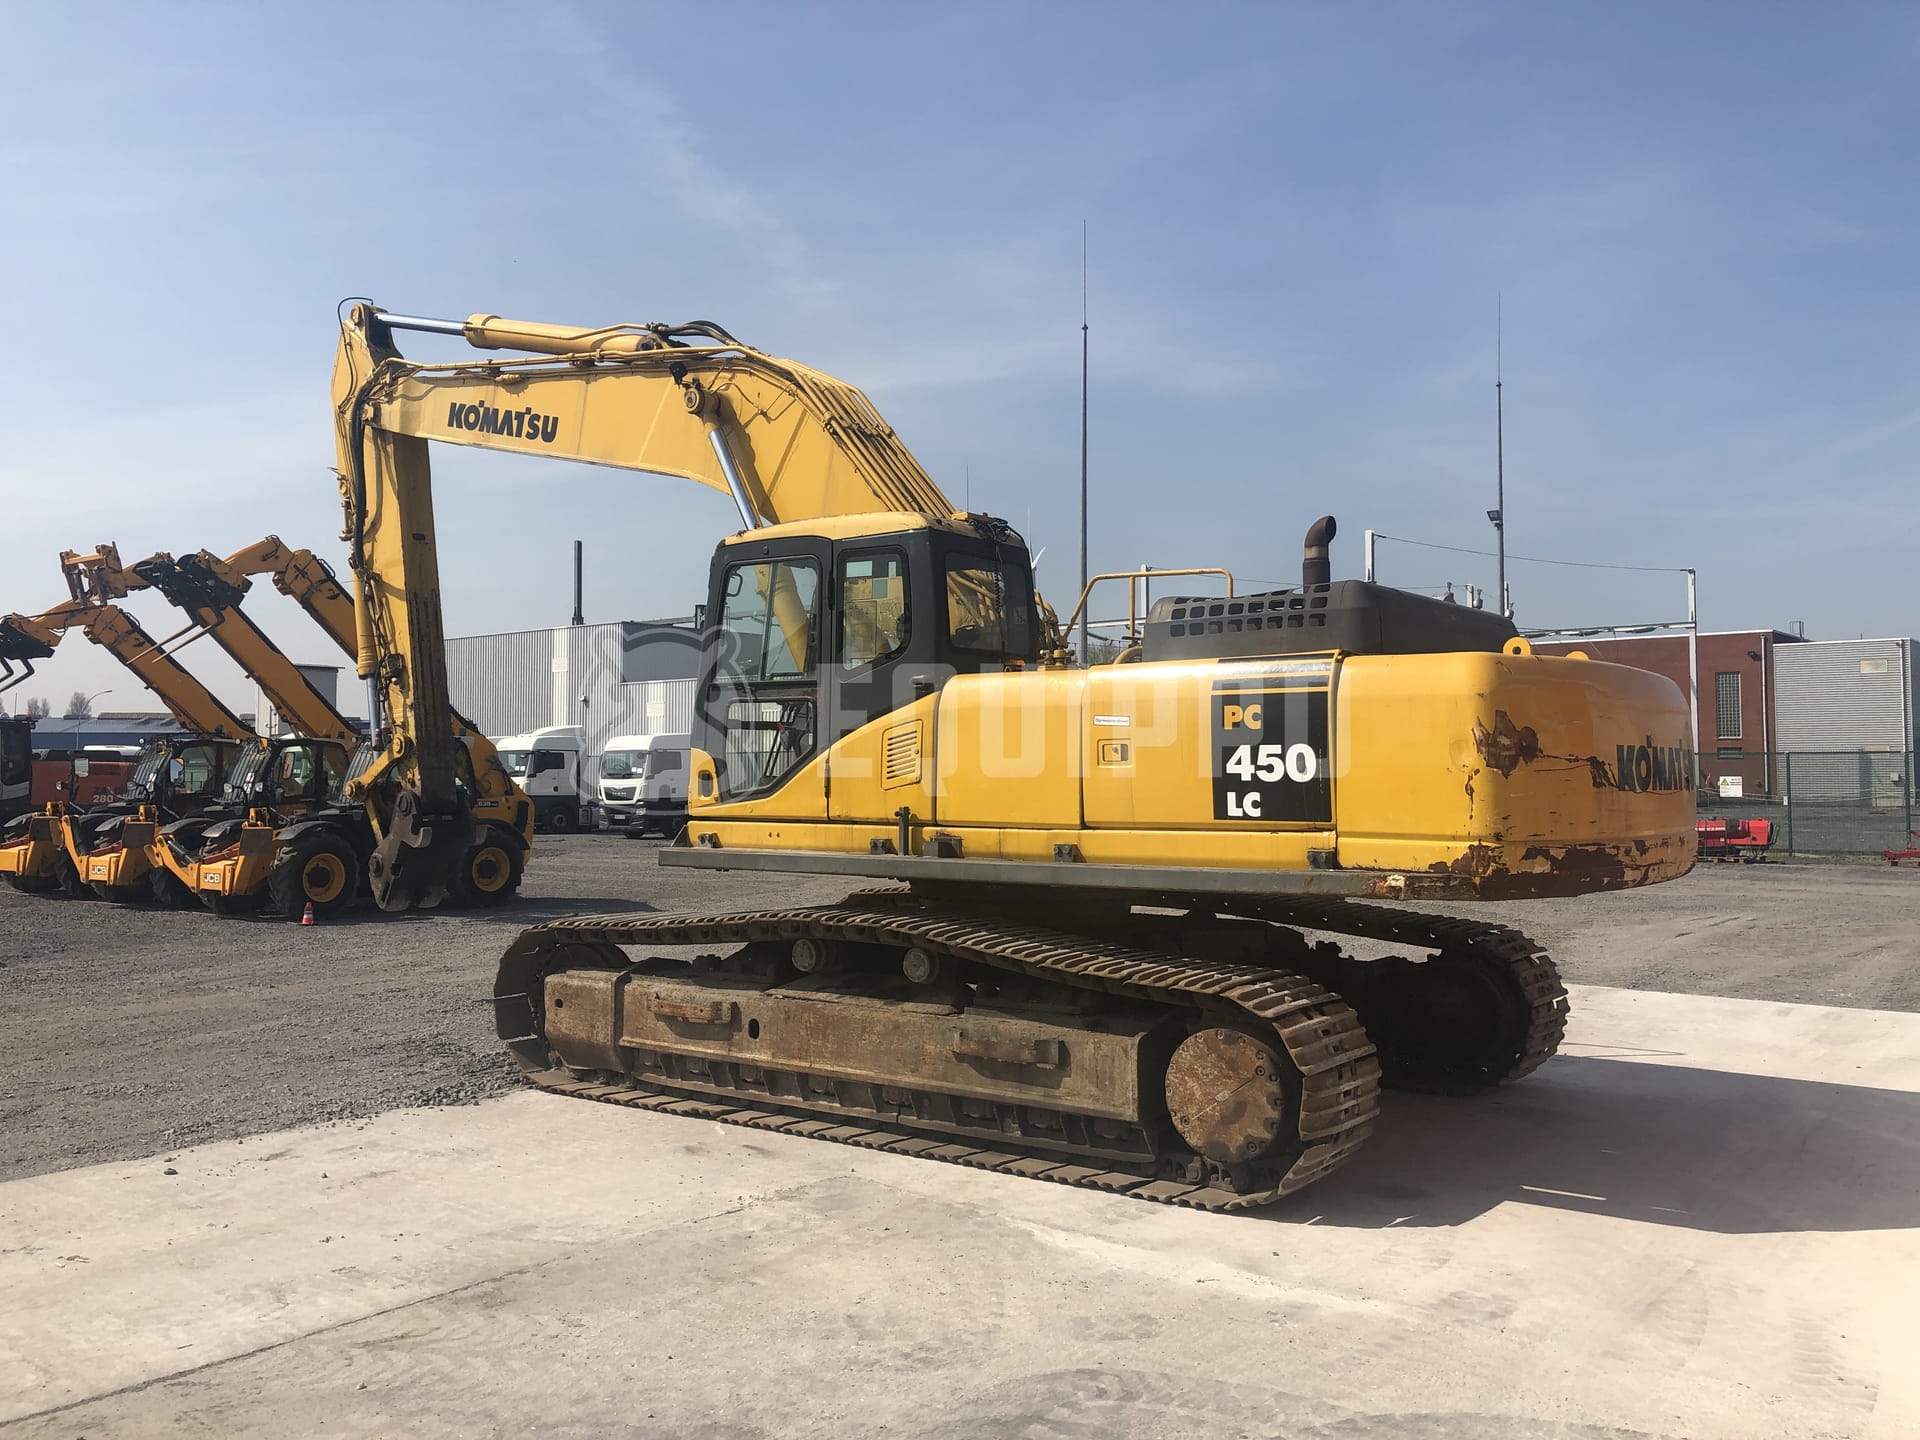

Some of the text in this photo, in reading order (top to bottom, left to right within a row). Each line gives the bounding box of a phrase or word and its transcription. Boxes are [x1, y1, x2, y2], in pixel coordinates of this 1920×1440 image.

[447, 400, 559, 443] KOMATSU
[1223, 704, 1262, 730] PC
[1226, 743, 1317, 783] 450
[93, 794, 114, 803] 280
[1227, 791, 1261, 817] LC
[92, 866, 107, 875] JCB
[205, 873, 220, 883] JCB
